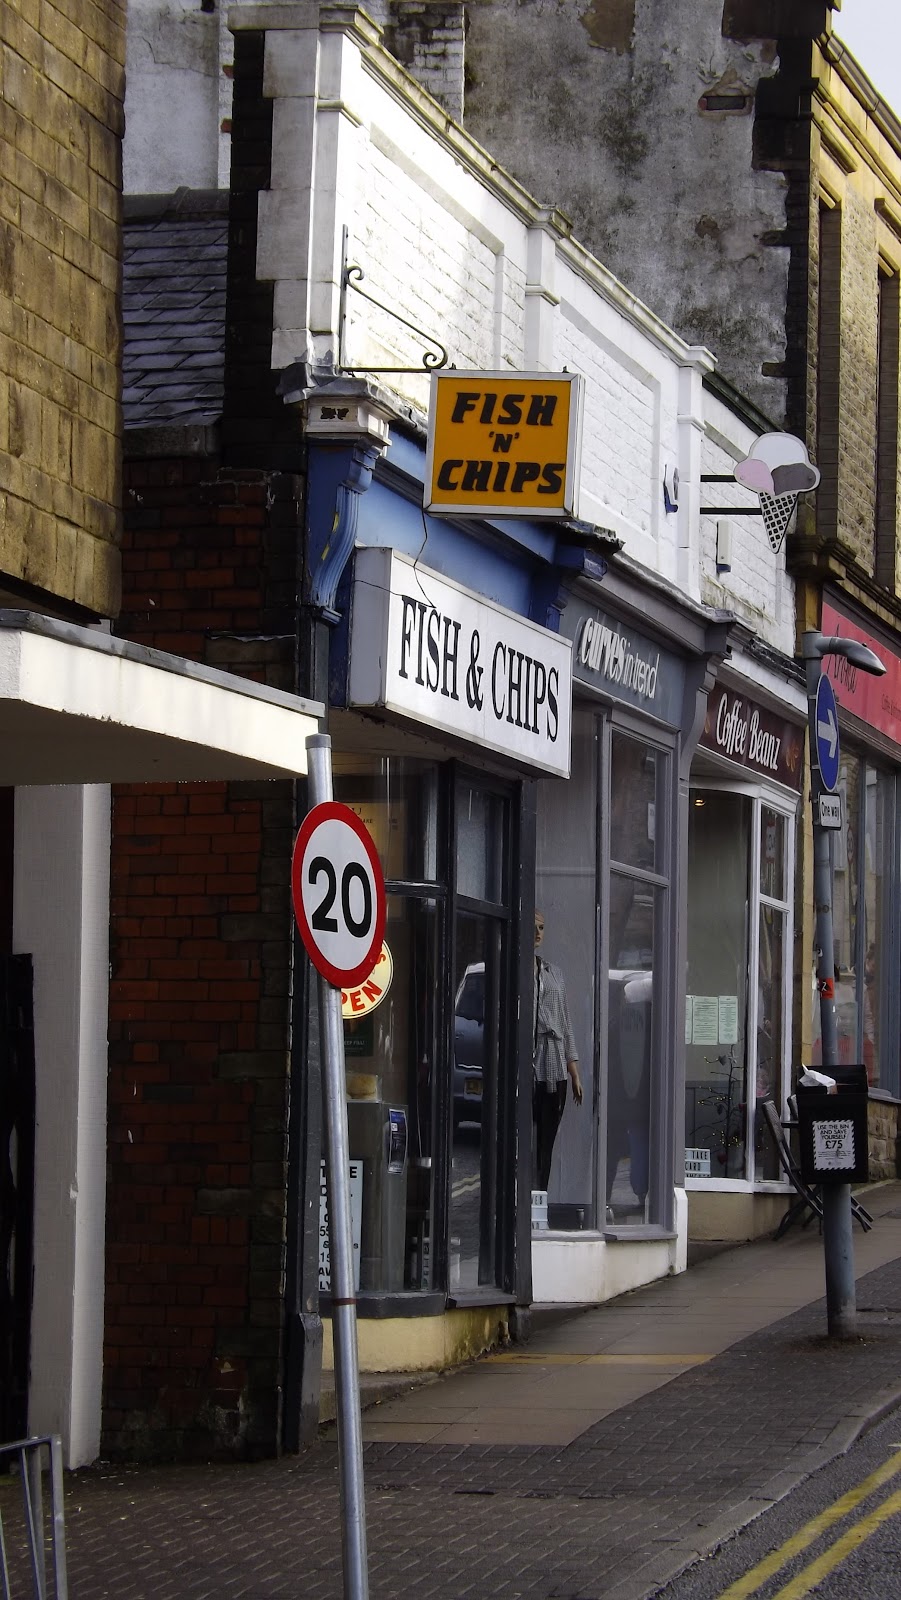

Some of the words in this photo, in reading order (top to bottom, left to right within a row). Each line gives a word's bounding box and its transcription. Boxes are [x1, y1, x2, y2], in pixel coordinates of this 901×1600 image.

[450, 392, 558, 426] FISH
[436, 459, 566, 494] CHIPS
[398, 595, 462, 702] FISH
[465, 629, 484, 712] &
[491, 641, 560, 743] CHIPS
[715, 692, 747, 756] Coffee
[748, 709, 782, 771] Beanz
[308, 856, 372, 938] 20
[341, 979, 383, 1012] PEN
[825, 1140, 843, 1149] £75
